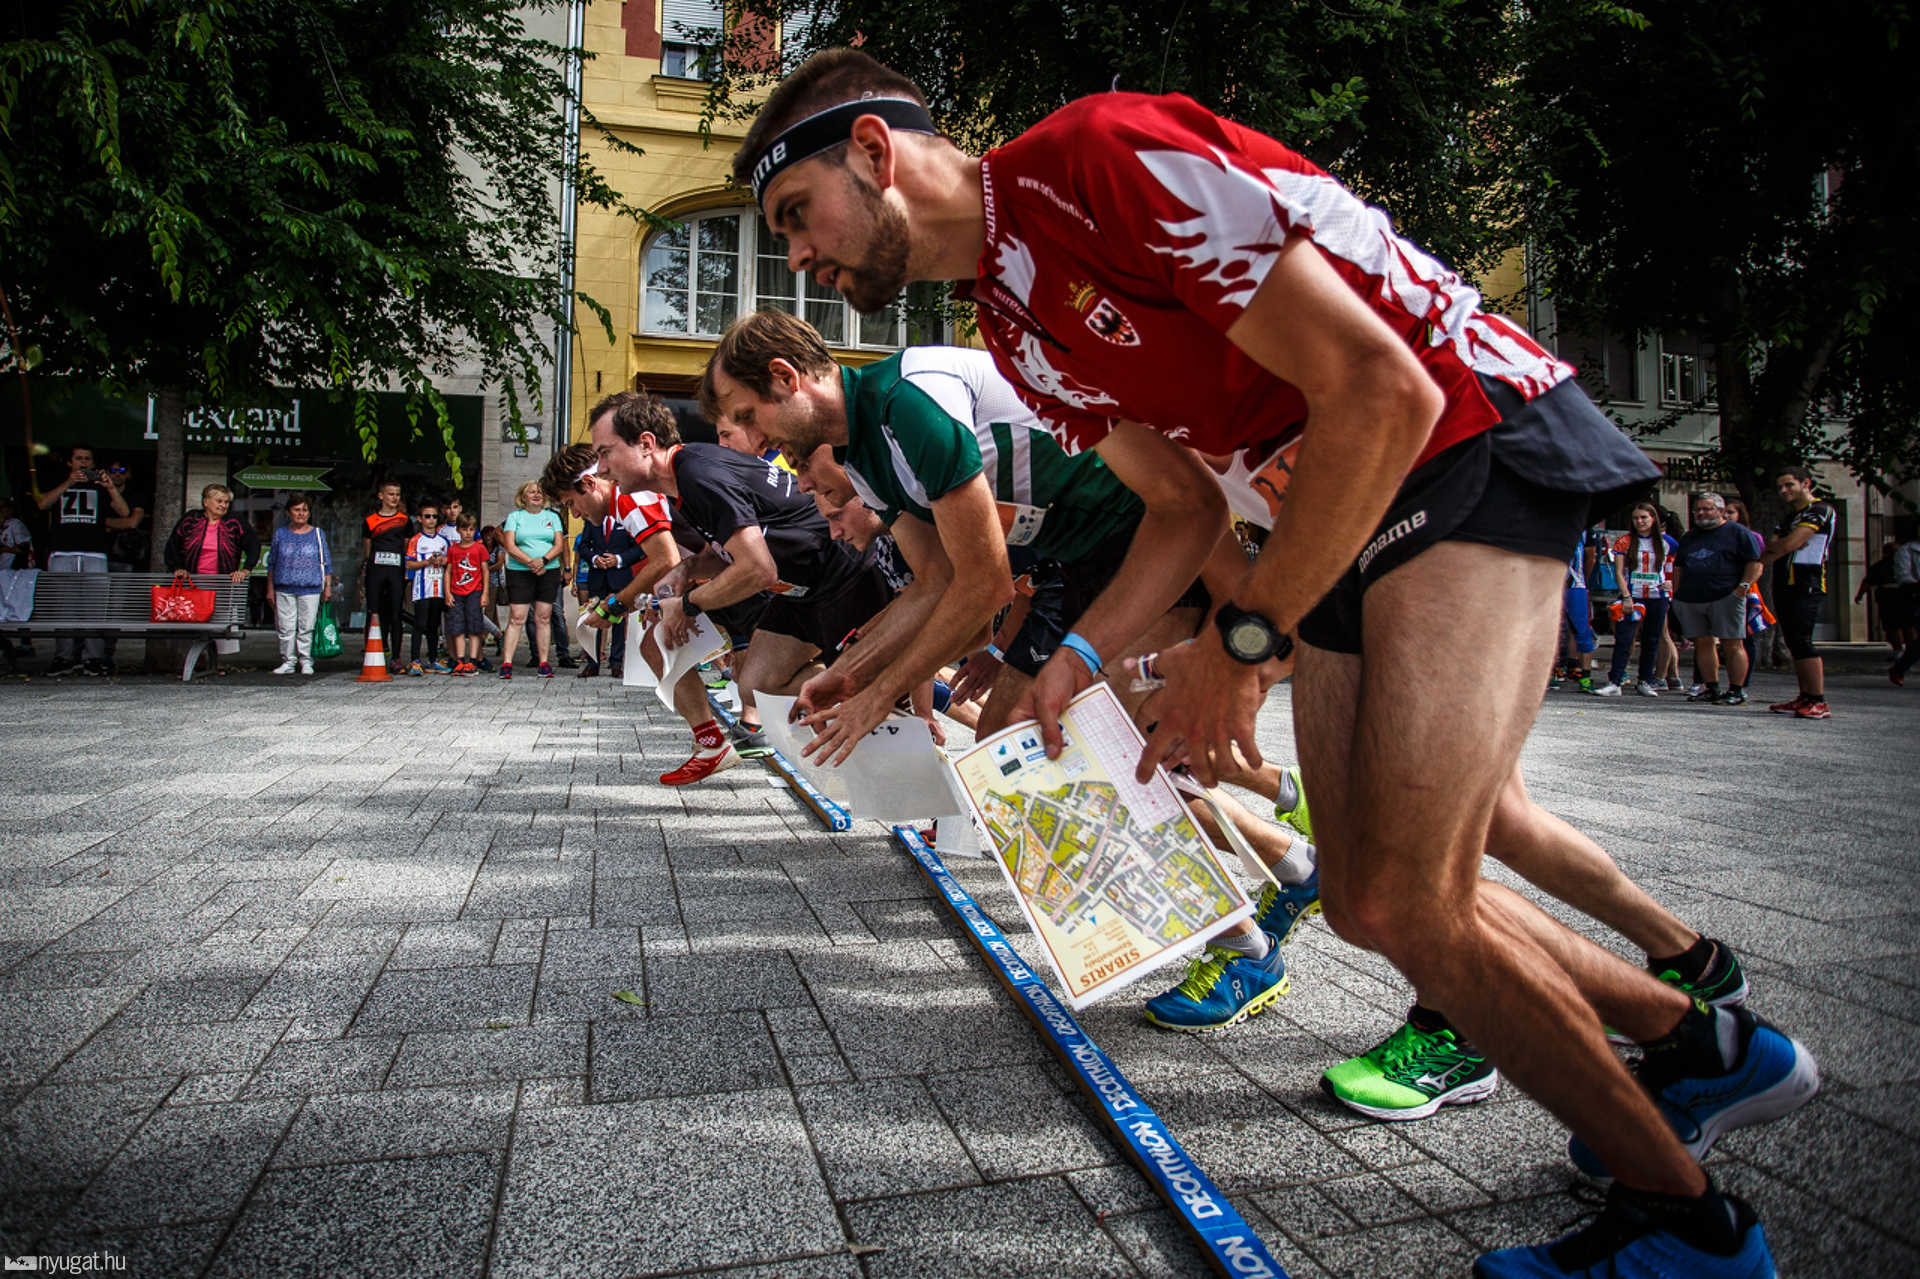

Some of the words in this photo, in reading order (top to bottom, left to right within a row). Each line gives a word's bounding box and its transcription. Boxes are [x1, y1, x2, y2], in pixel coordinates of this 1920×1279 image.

[1080, 947, 1141, 988] SIBARIS
[1022, 984, 1079, 1036] DECATHLON
[1068, 1043, 1138, 1112] DECATHLON
[1128, 1120, 1223, 1220] DECATHLON
